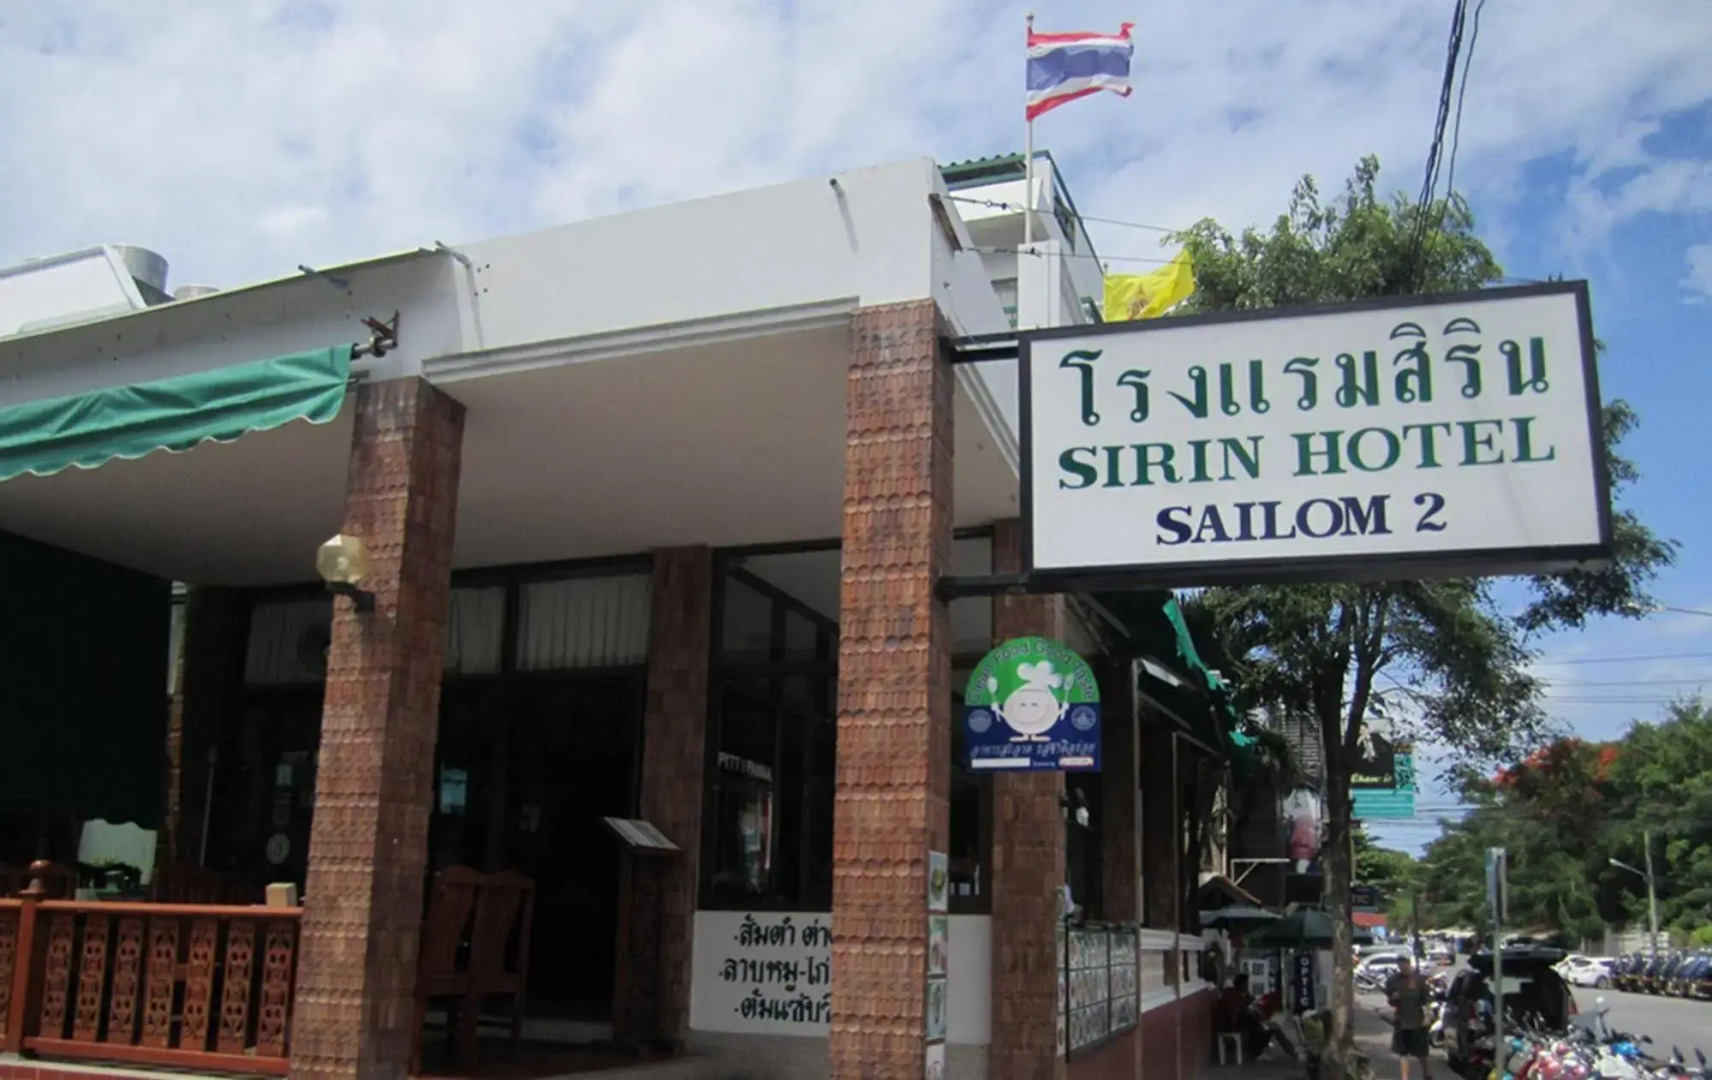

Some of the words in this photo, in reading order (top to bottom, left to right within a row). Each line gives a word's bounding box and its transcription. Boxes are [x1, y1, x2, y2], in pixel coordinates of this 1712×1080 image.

[1059, 317, 1549, 426] โรงแรมสิริน
[1058, 435, 1265, 490] SIRIN
[1291, 416, 1555, 477] HOTEL
[1156, 494, 1392, 546] SAILOM
[1414, 492, 1447, 532] 2
[994, 640, 1030, 663] Food
[1035, 640, 1072, 665] Good
[1073, 660, 1094, 700] Taste
